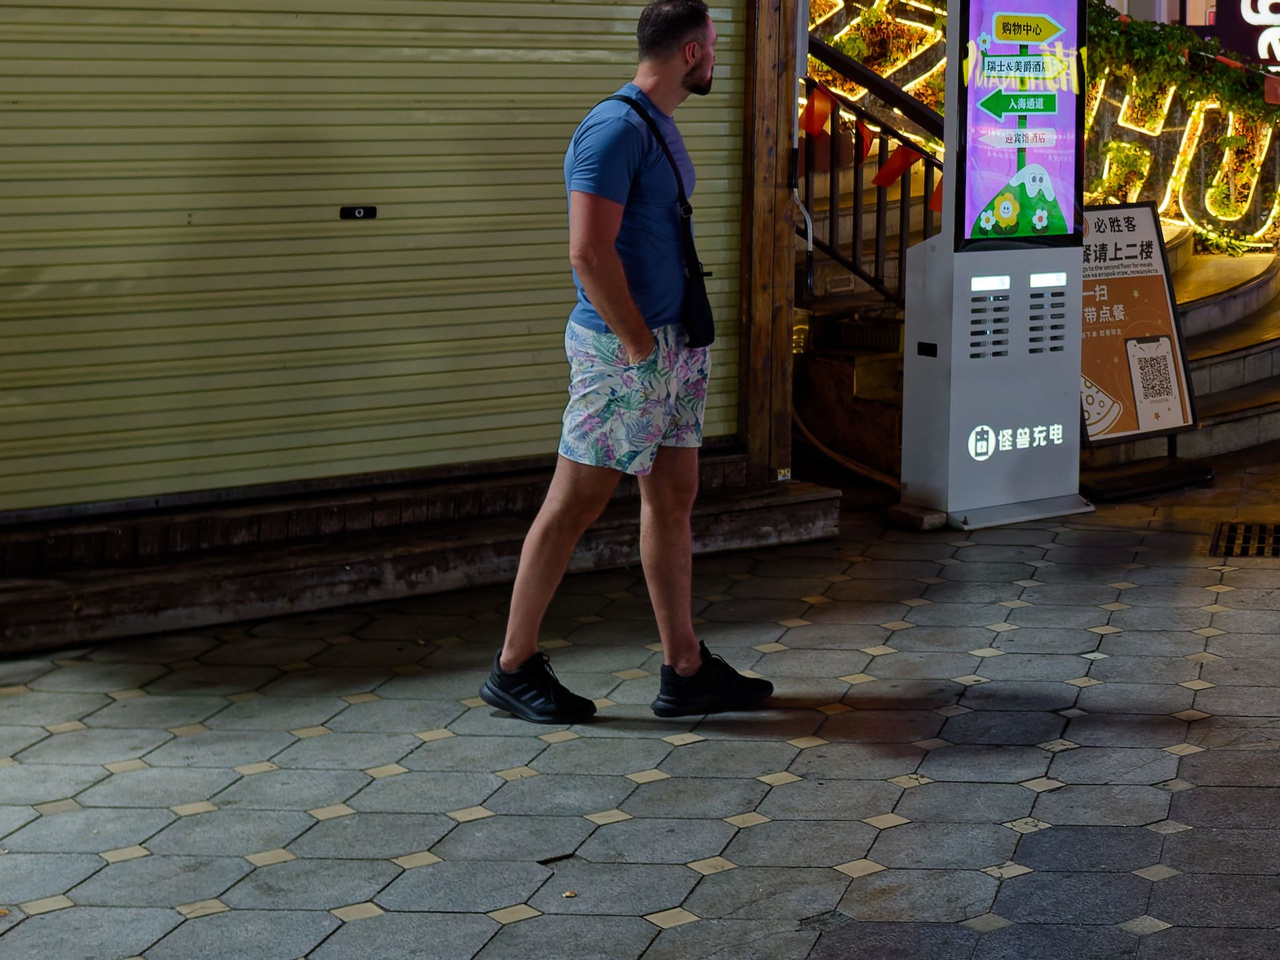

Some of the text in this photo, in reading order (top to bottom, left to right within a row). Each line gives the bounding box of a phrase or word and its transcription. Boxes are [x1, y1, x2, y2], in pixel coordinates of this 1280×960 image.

[1001, 21, 1042, 36] 购物中心
[1008, 97, 1044, 110] 入海通道
[1004, 132, 1046, 145] 迎宾馆酒店
[1094, 216, 1137, 234] 必胜客
[998, 424, 1064, 451] 怪兽充电
